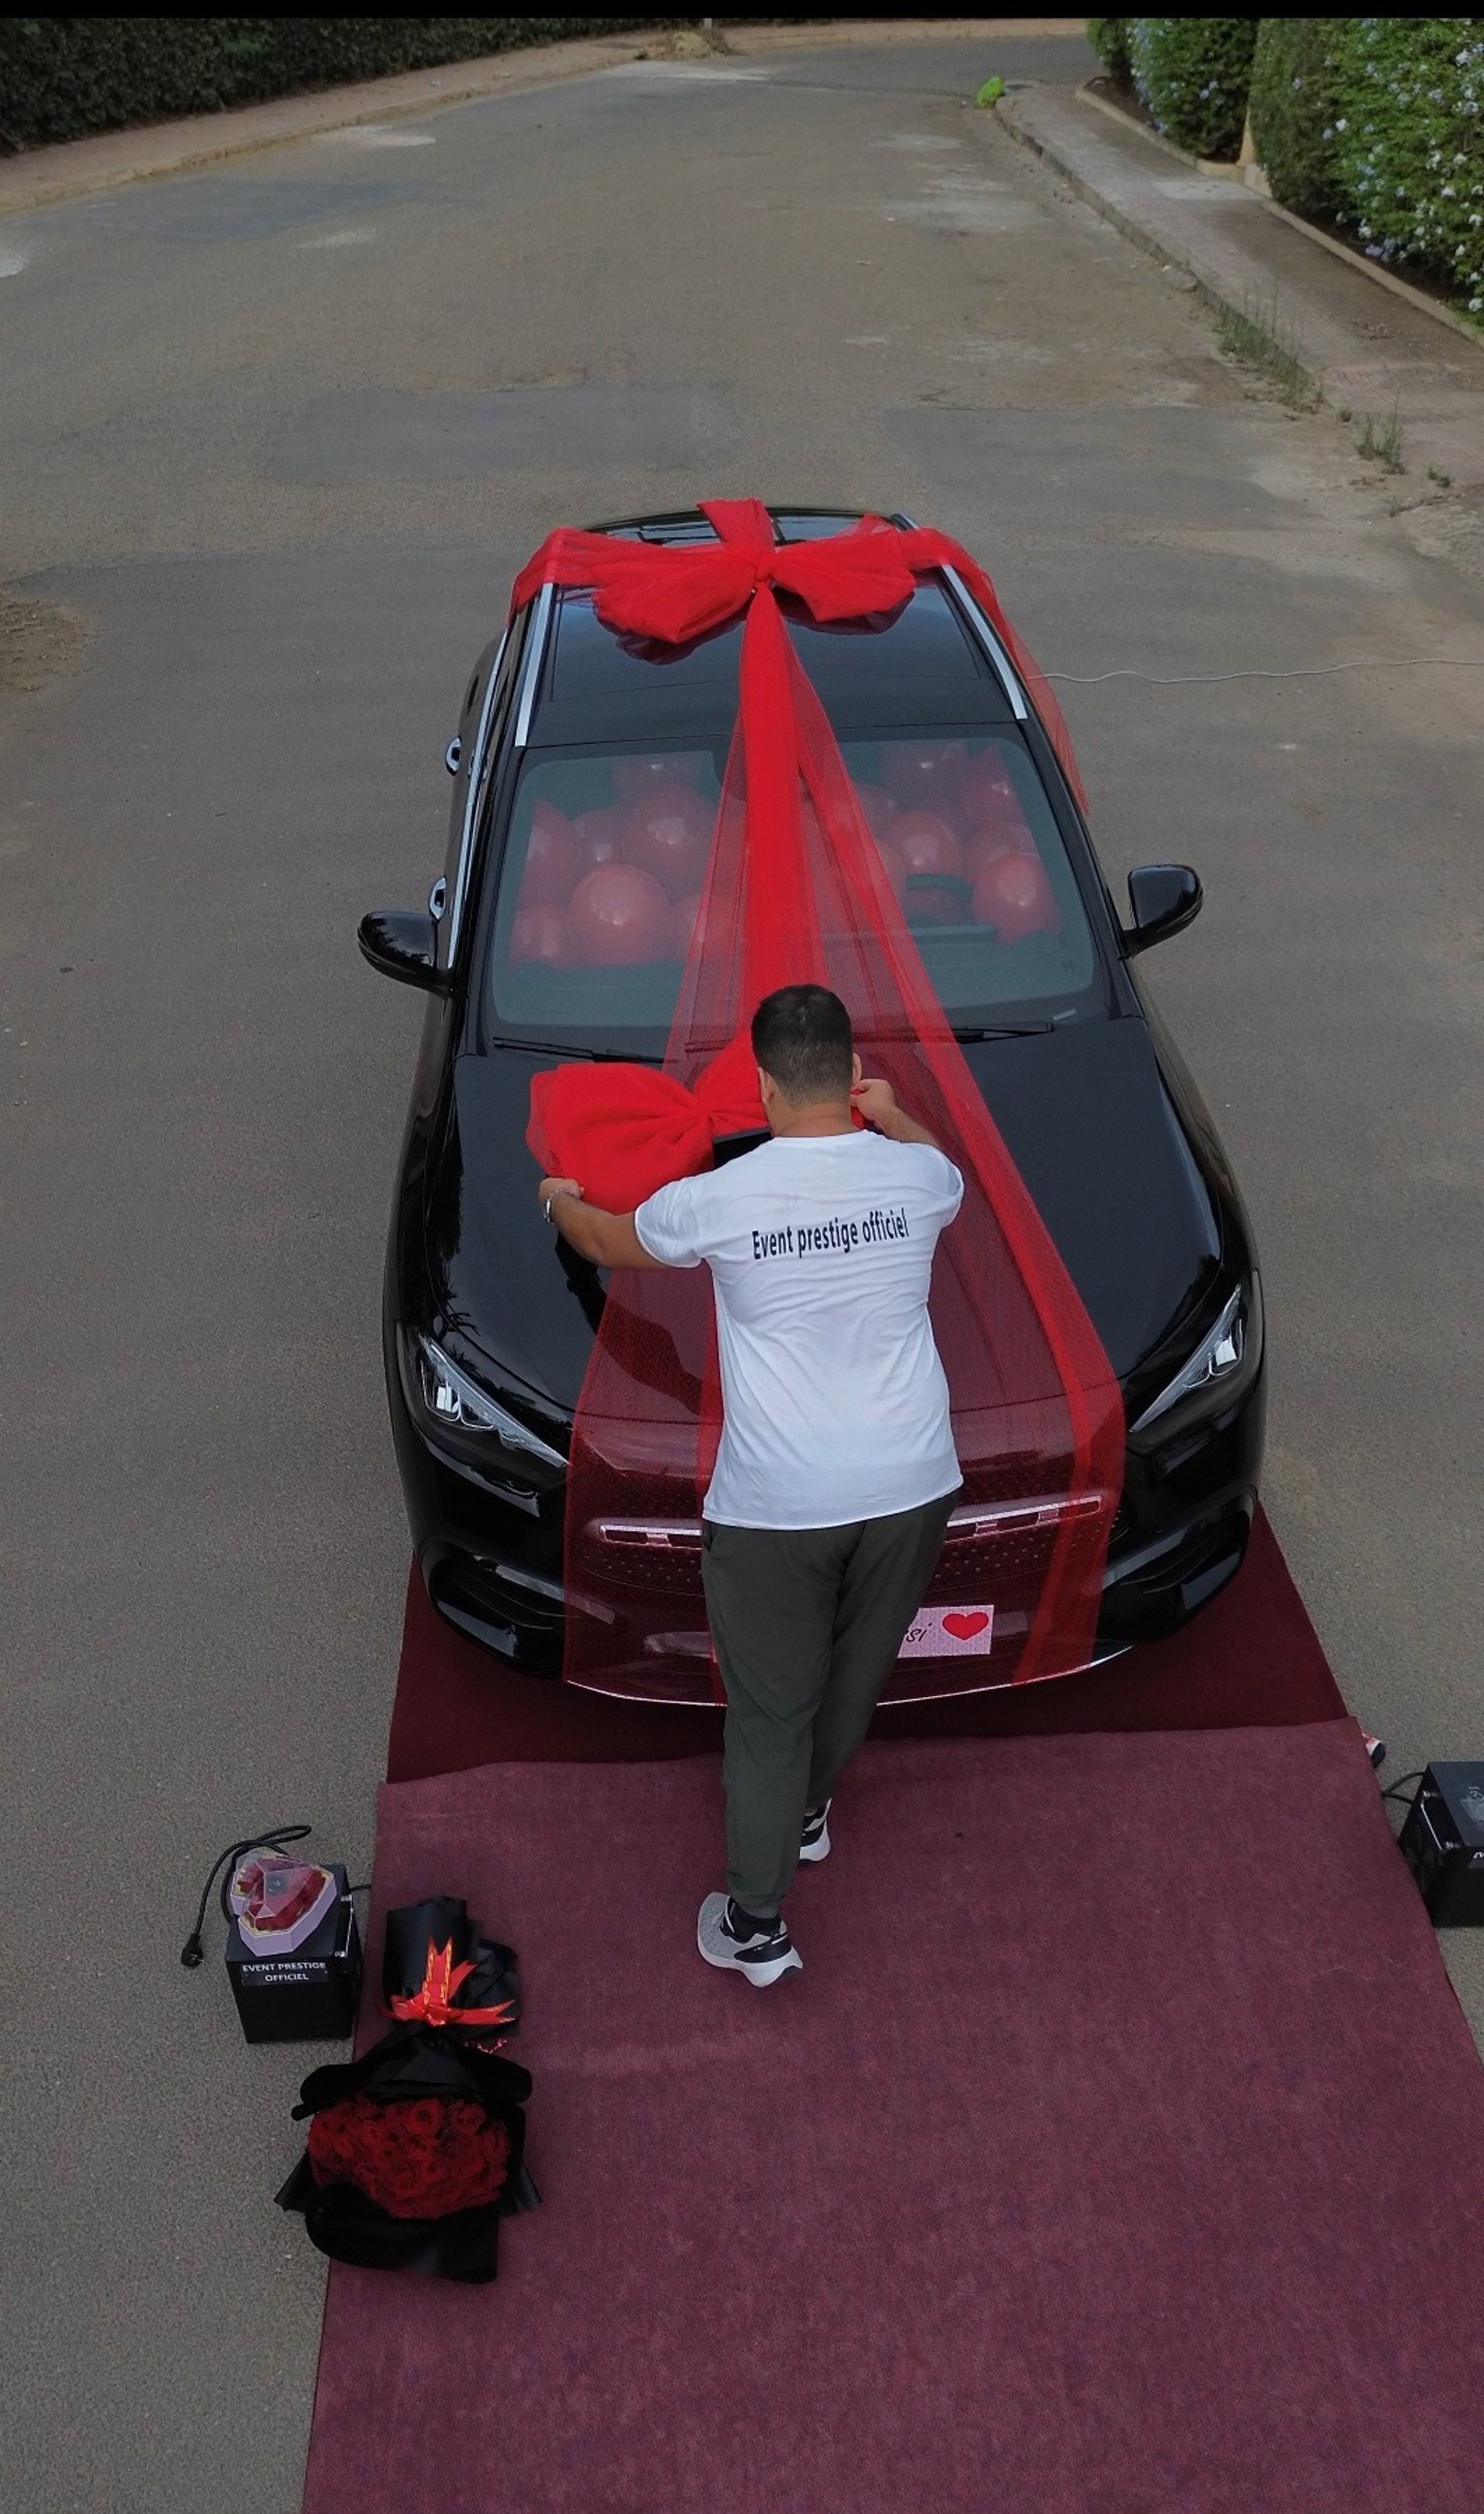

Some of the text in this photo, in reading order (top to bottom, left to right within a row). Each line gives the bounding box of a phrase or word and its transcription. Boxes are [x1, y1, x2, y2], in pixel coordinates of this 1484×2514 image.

[752, 1207, 910, 1260] Event prestige officiel
[905, 1623, 932, 1643] si
[242, 1962, 326, 1972] EVENT PRESTIGE
[264, 1973, 309, 1982] OFFICIEL
